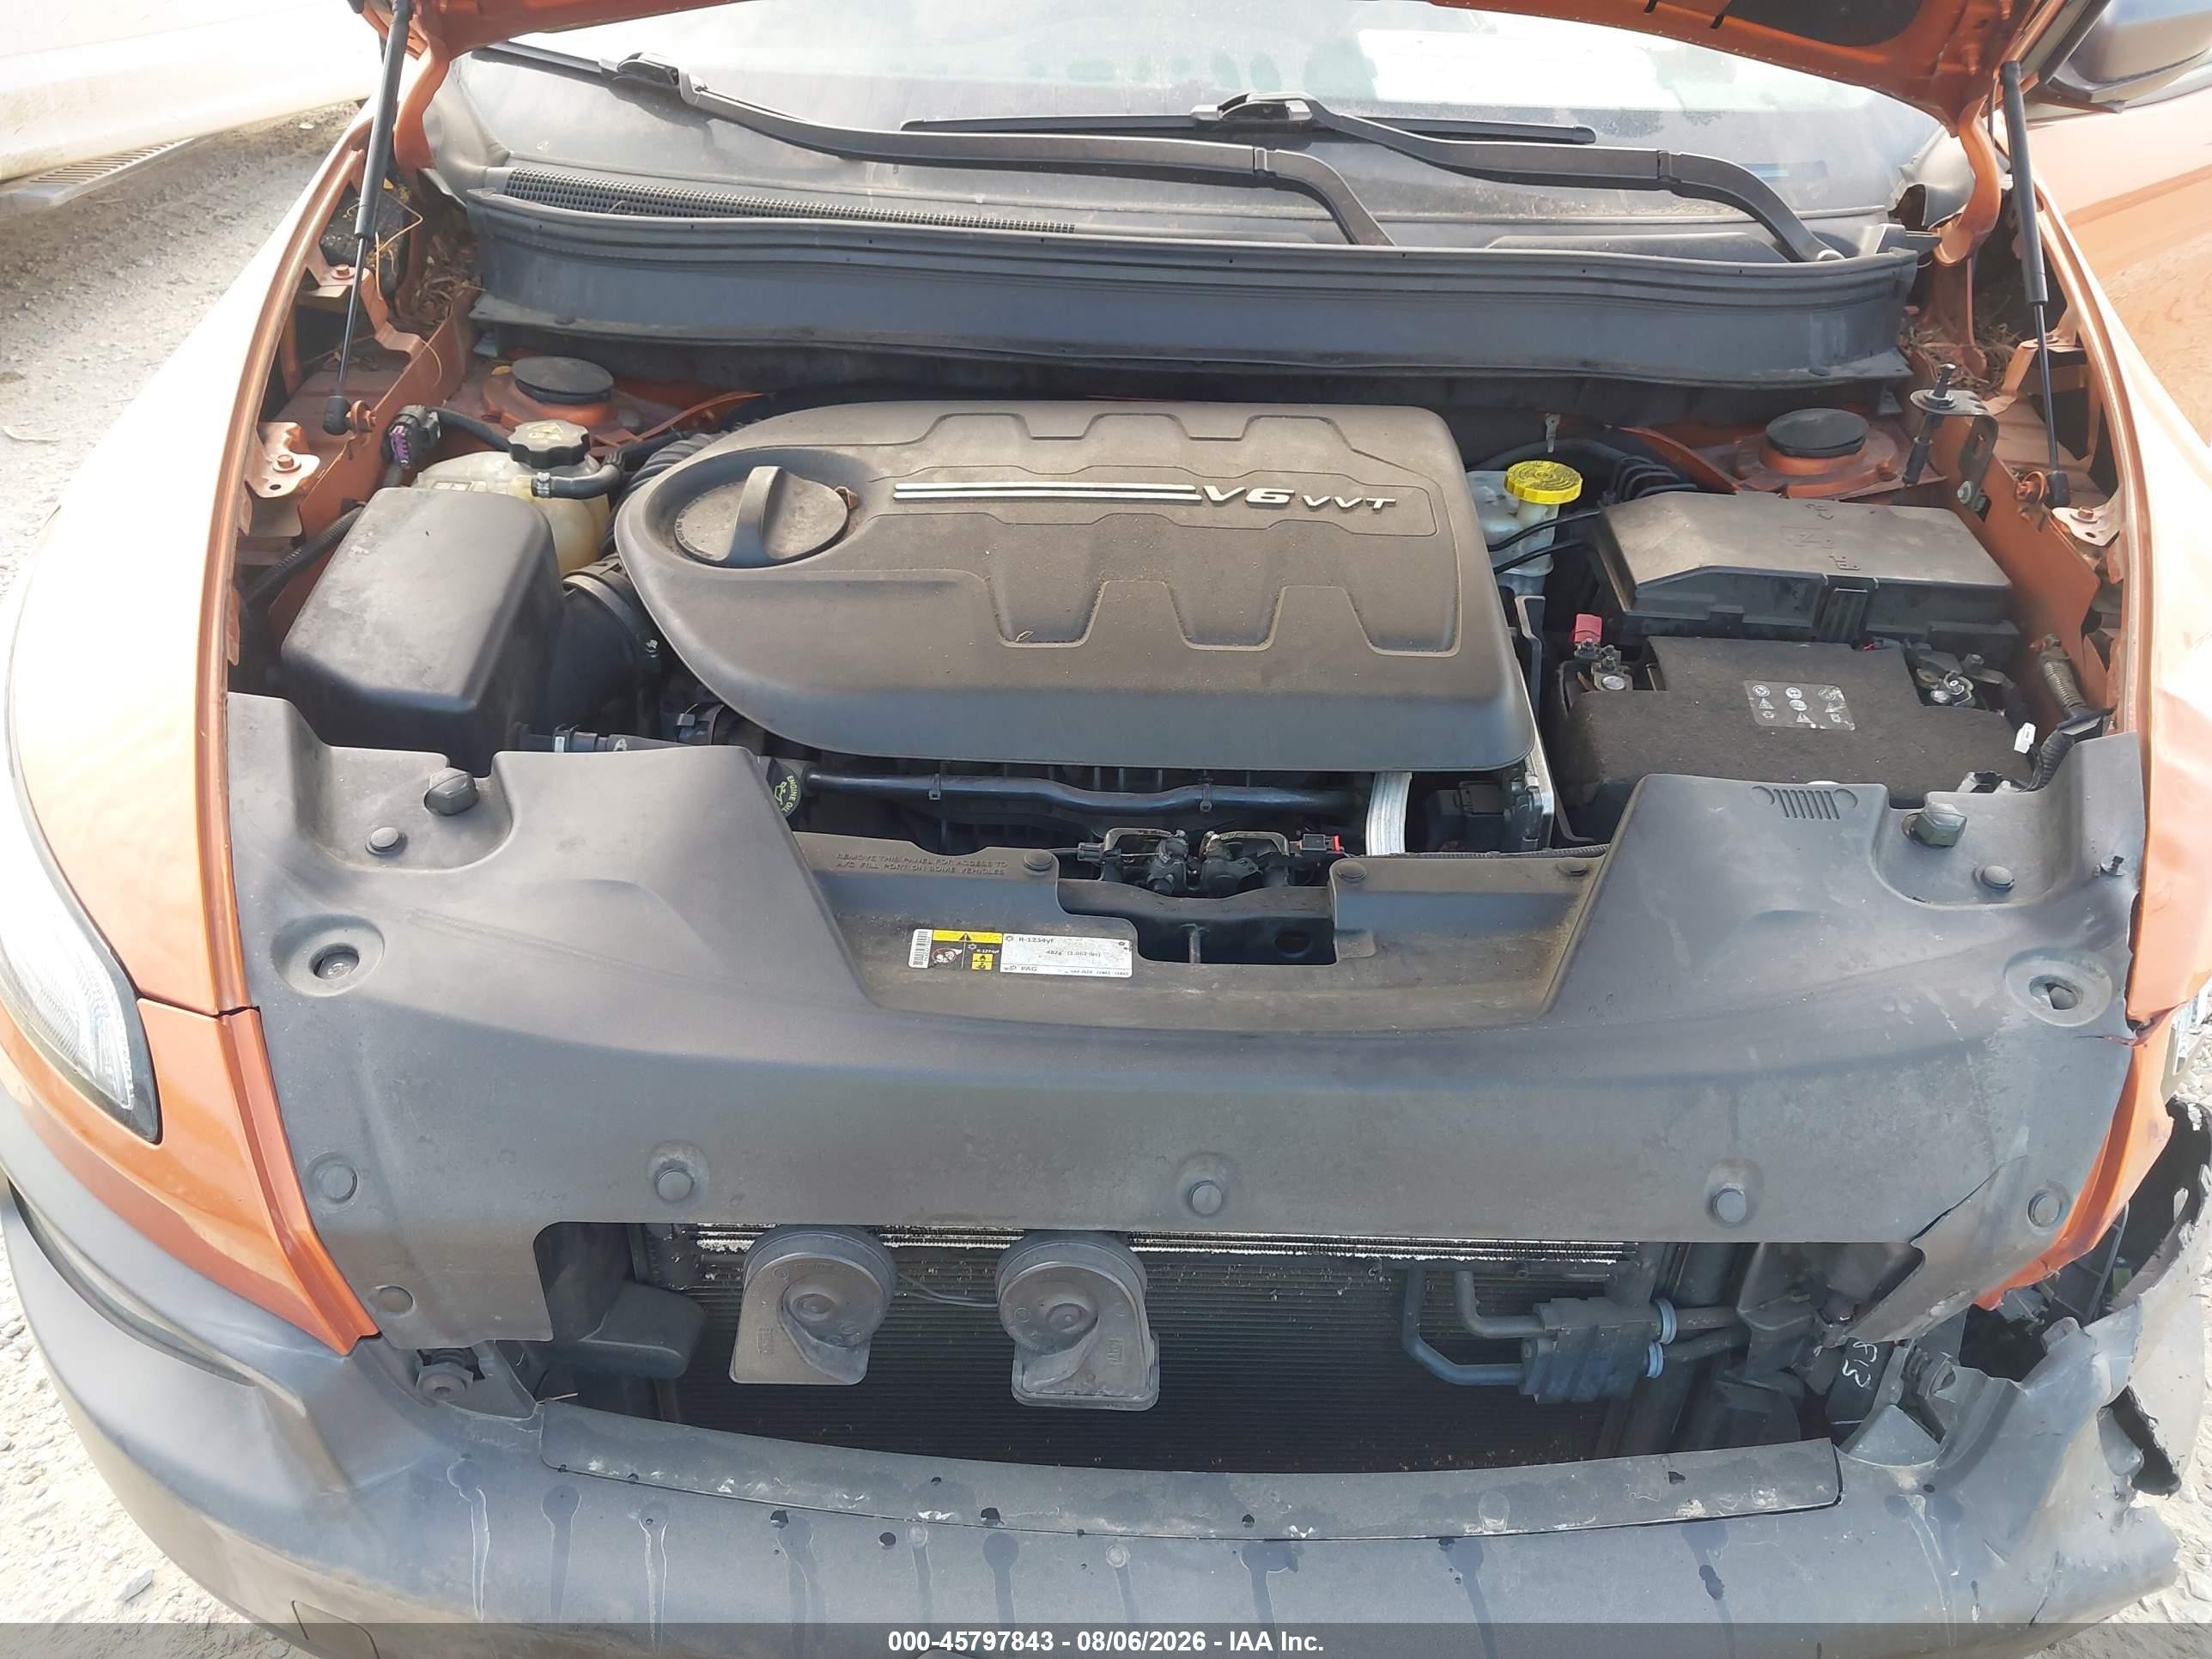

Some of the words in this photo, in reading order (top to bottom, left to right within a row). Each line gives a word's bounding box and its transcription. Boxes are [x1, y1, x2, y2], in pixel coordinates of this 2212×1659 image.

[1203, 485, 1296, 506] V6
[1302, 495, 1397, 511] VVT
[786, 775, 798, 801] ENGINE
[781, 801, 793, 812] OIL
[961, 866, 1006, 875] VEHICLES
